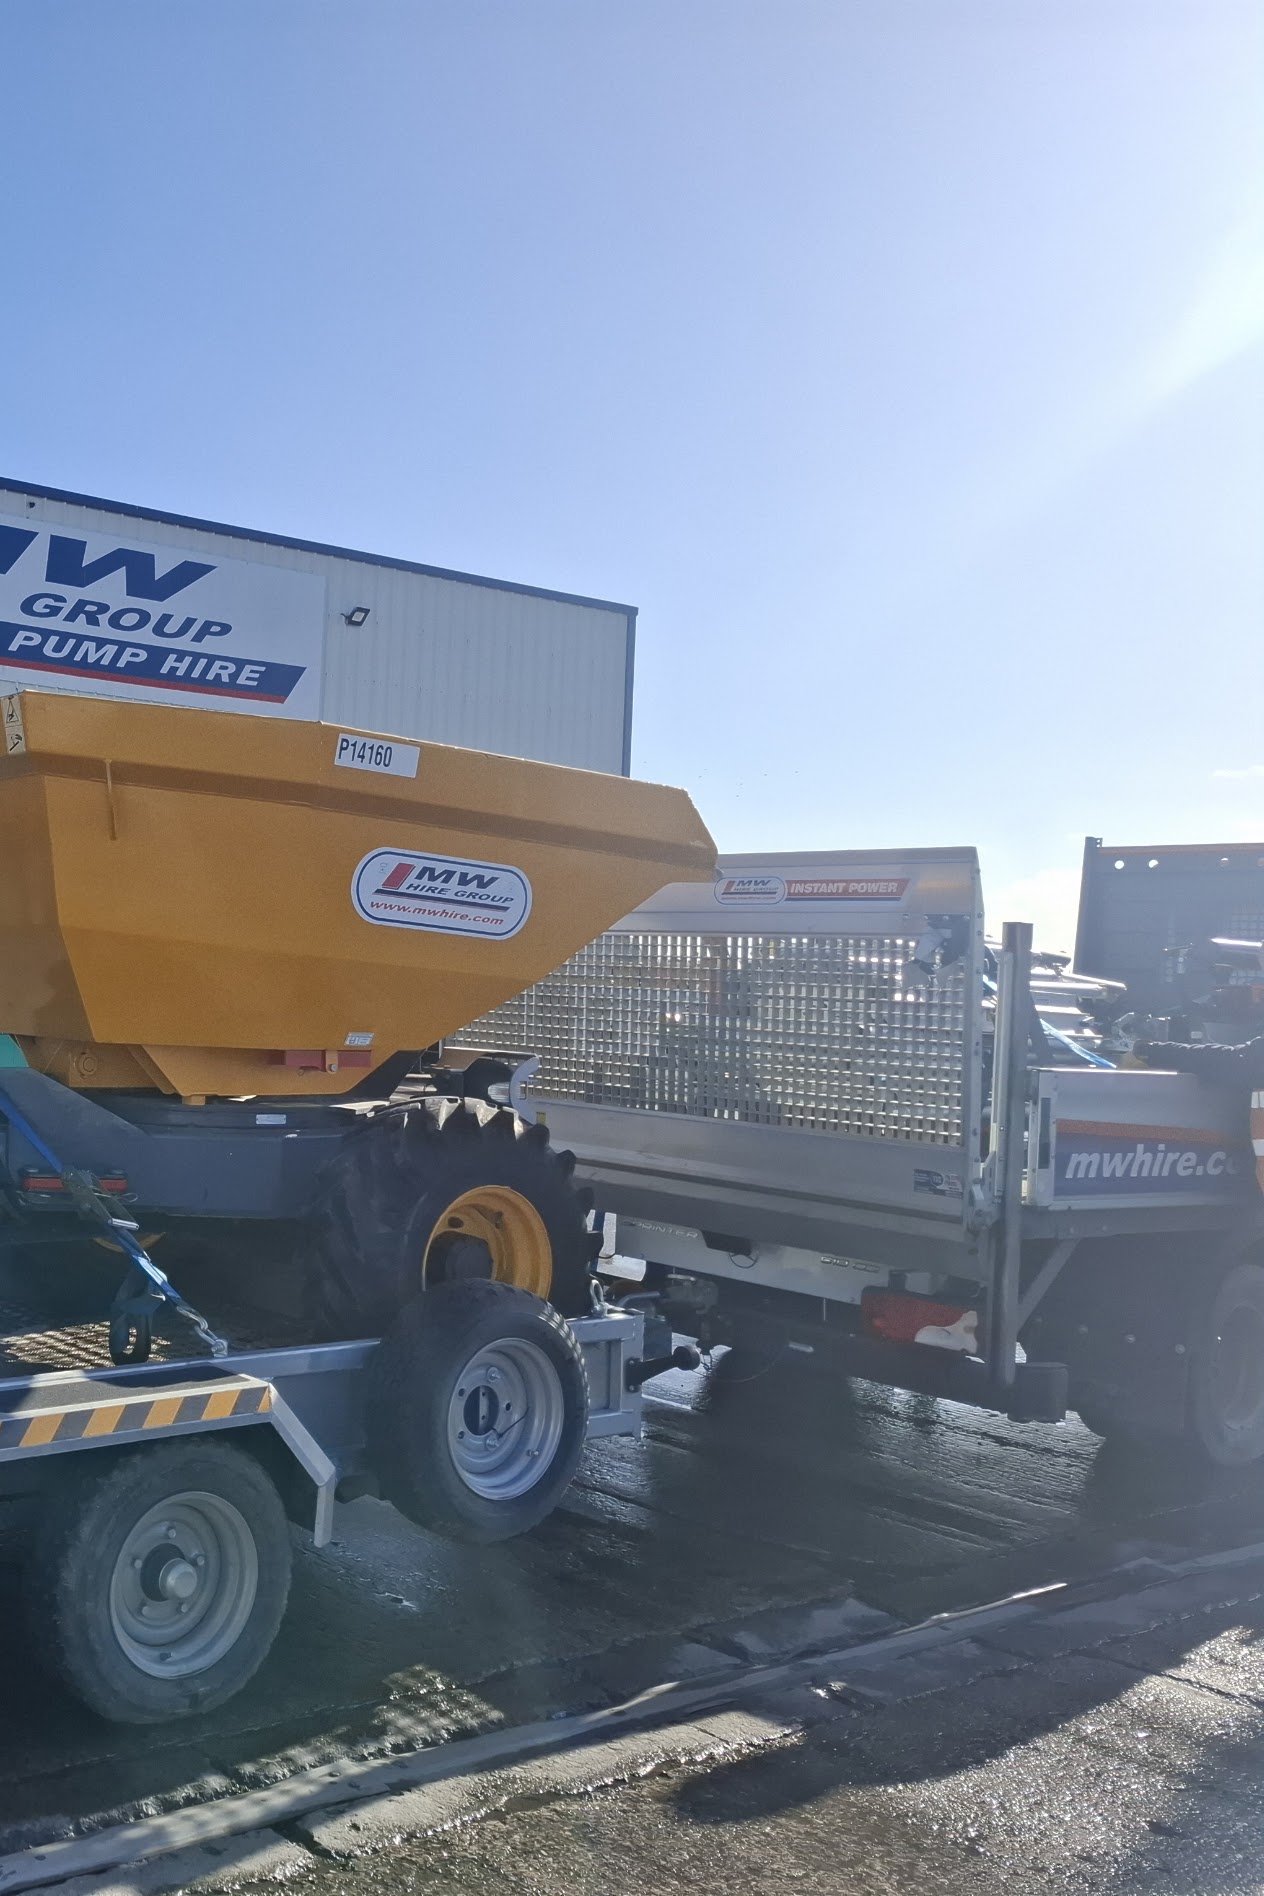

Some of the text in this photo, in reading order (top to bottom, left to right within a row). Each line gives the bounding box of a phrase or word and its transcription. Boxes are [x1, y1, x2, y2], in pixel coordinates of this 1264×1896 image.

[19, 592, 233, 645] GROUP
[7, 631, 148, 670] PUMP
[159, 655, 266, 687] HIRE
[338, 738, 393, 768] P14160
[414, 866, 499, 890] MW
[790, 882, 898, 894] INSTANT POWER
[405, 883, 515, 904] HIRE GROUP
[370, 900, 504, 925] www.mwhire.com
